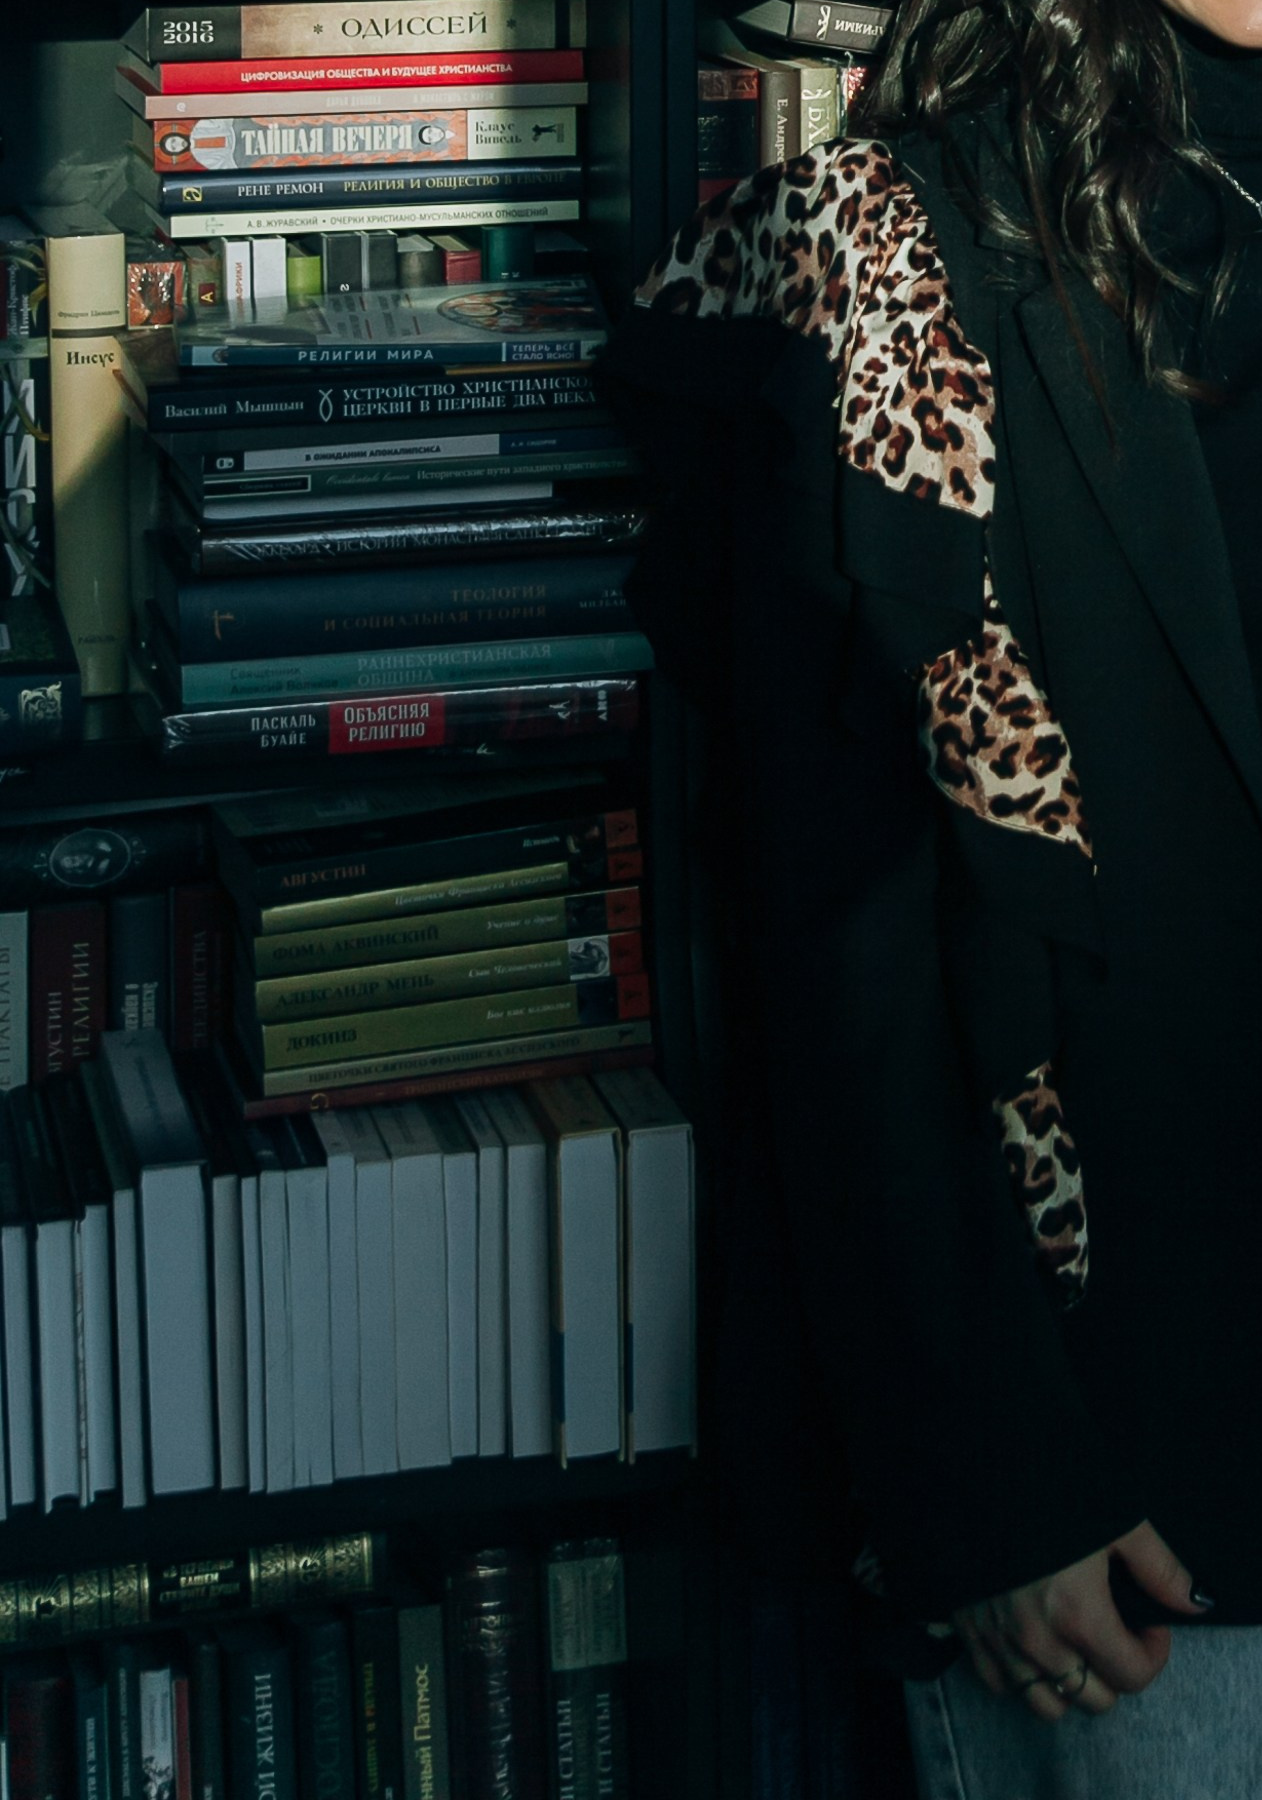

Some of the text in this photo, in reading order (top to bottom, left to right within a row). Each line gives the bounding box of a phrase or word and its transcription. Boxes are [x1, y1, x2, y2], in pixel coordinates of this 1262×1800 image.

[163, 21, 213, 33] 2015
[341, 11, 488, 40] ОДИССЕЙ
[163, 32, 214, 44] 2016
[241, 62, 512, 83] ЦИФРОВИЗАЦИЯ ОБЩЕСТВА И БУДУЩЕЕ ХРИСТИАНСТВА
[241, 122, 412, 157] ТАЙНАЯ ВЕЧЕРЯ
[238, 185, 272, 197] РЕНЕ
[276, 182, 324, 196] РЕМОН
[344, 178, 405, 193] РЕЛИГИЯ
[426, 174, 499, 190] ОБЩЕСТВО
[344, 702, 430, 725] ОБЪЯСНЯЯ
[349, 721, 425, 742] РЕЛИГИЮ
